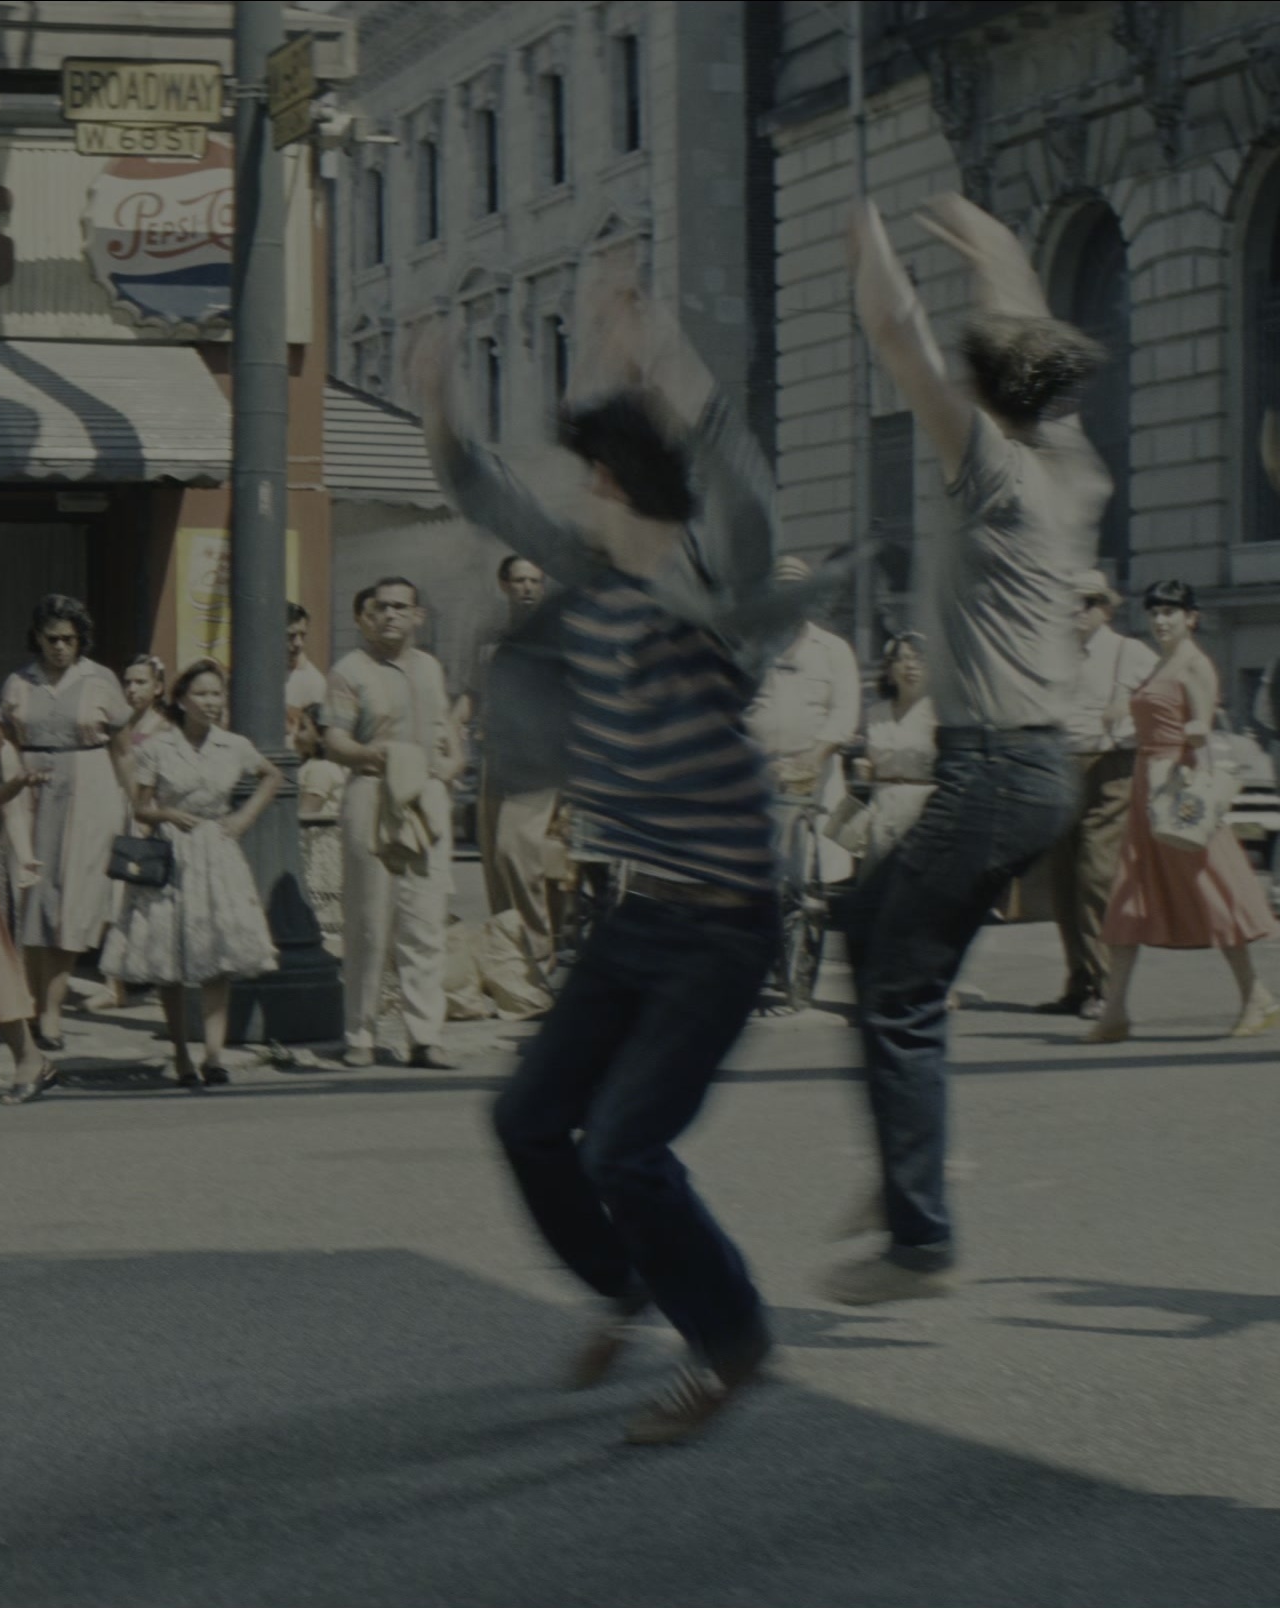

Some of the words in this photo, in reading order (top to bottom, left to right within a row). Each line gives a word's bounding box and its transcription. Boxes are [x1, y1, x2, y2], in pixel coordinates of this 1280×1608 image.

[68, 70, 216, 112] BROADWAY
[121, 129, 158, 150] 68
[166, 128, 199, 151] ST
